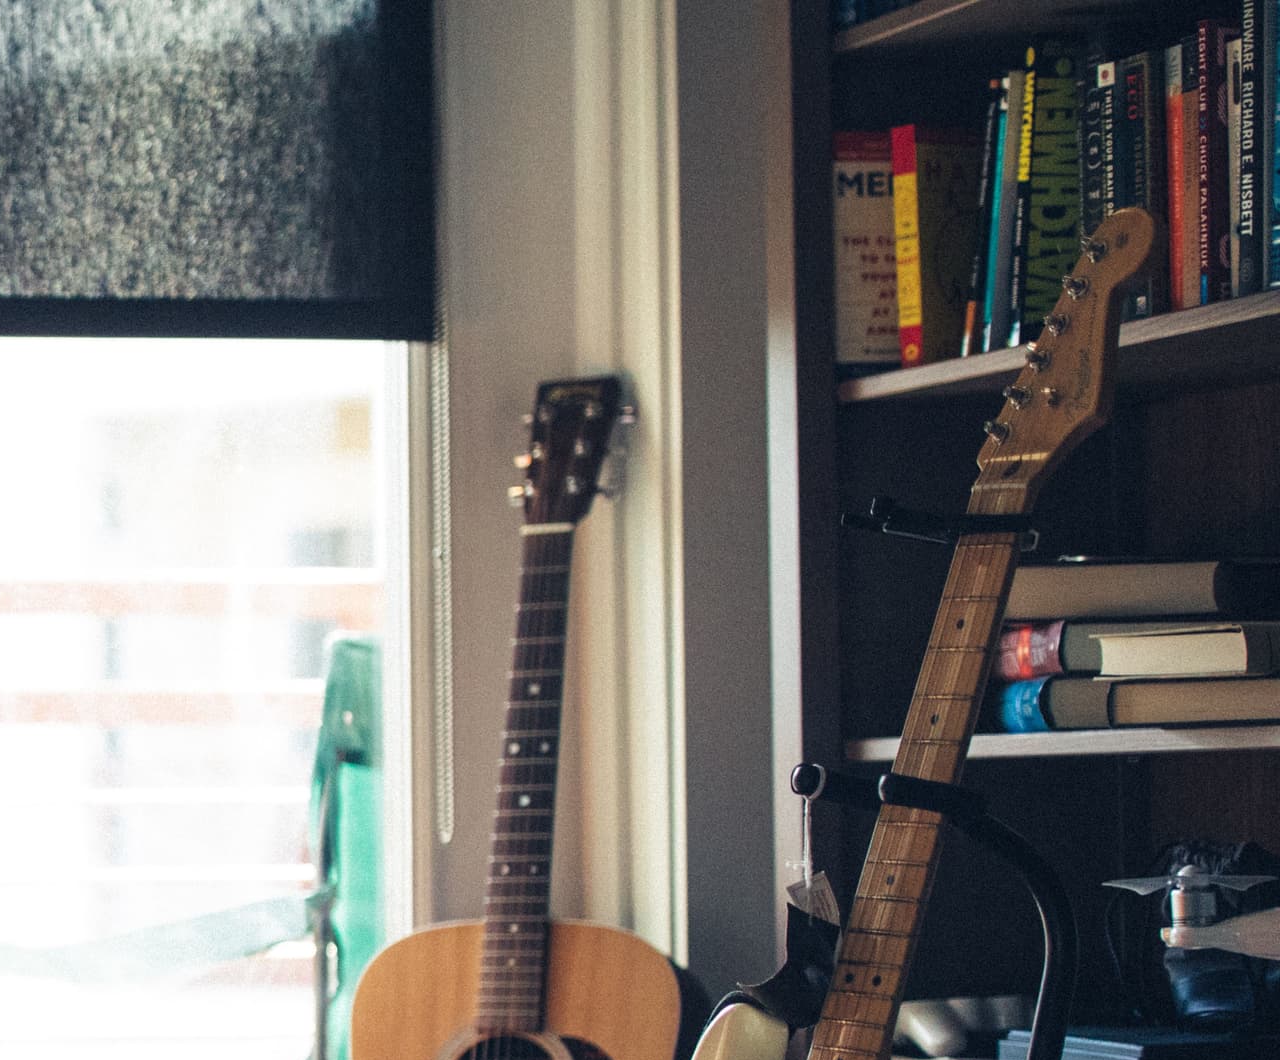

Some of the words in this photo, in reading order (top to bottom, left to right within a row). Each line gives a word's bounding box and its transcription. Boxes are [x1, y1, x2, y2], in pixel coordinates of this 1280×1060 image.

[1198, 27, 1207, 73] FIGHT
[1104, 89, 1114, 115] THIS
[1199, 76, 1207, 112] CLUB
[1017, 71, 1035, 182] WATCHMEN
[1105, 119, 1114, 130] IS
[1241, 81, 1254, 151] RICHARD
[1106, 132, 1114, 163] YOUR
[1199, 135, 1208, 182] CHUCK
[1241, 154, 1254, 169] E.
[837, 171, 894, 198] ME
[1106, 165, 1114, 199] BRAIN
[1241, 173, 1254, 236] NISBETT
[1200, 187, 1209, 268] PALAHNIUK
